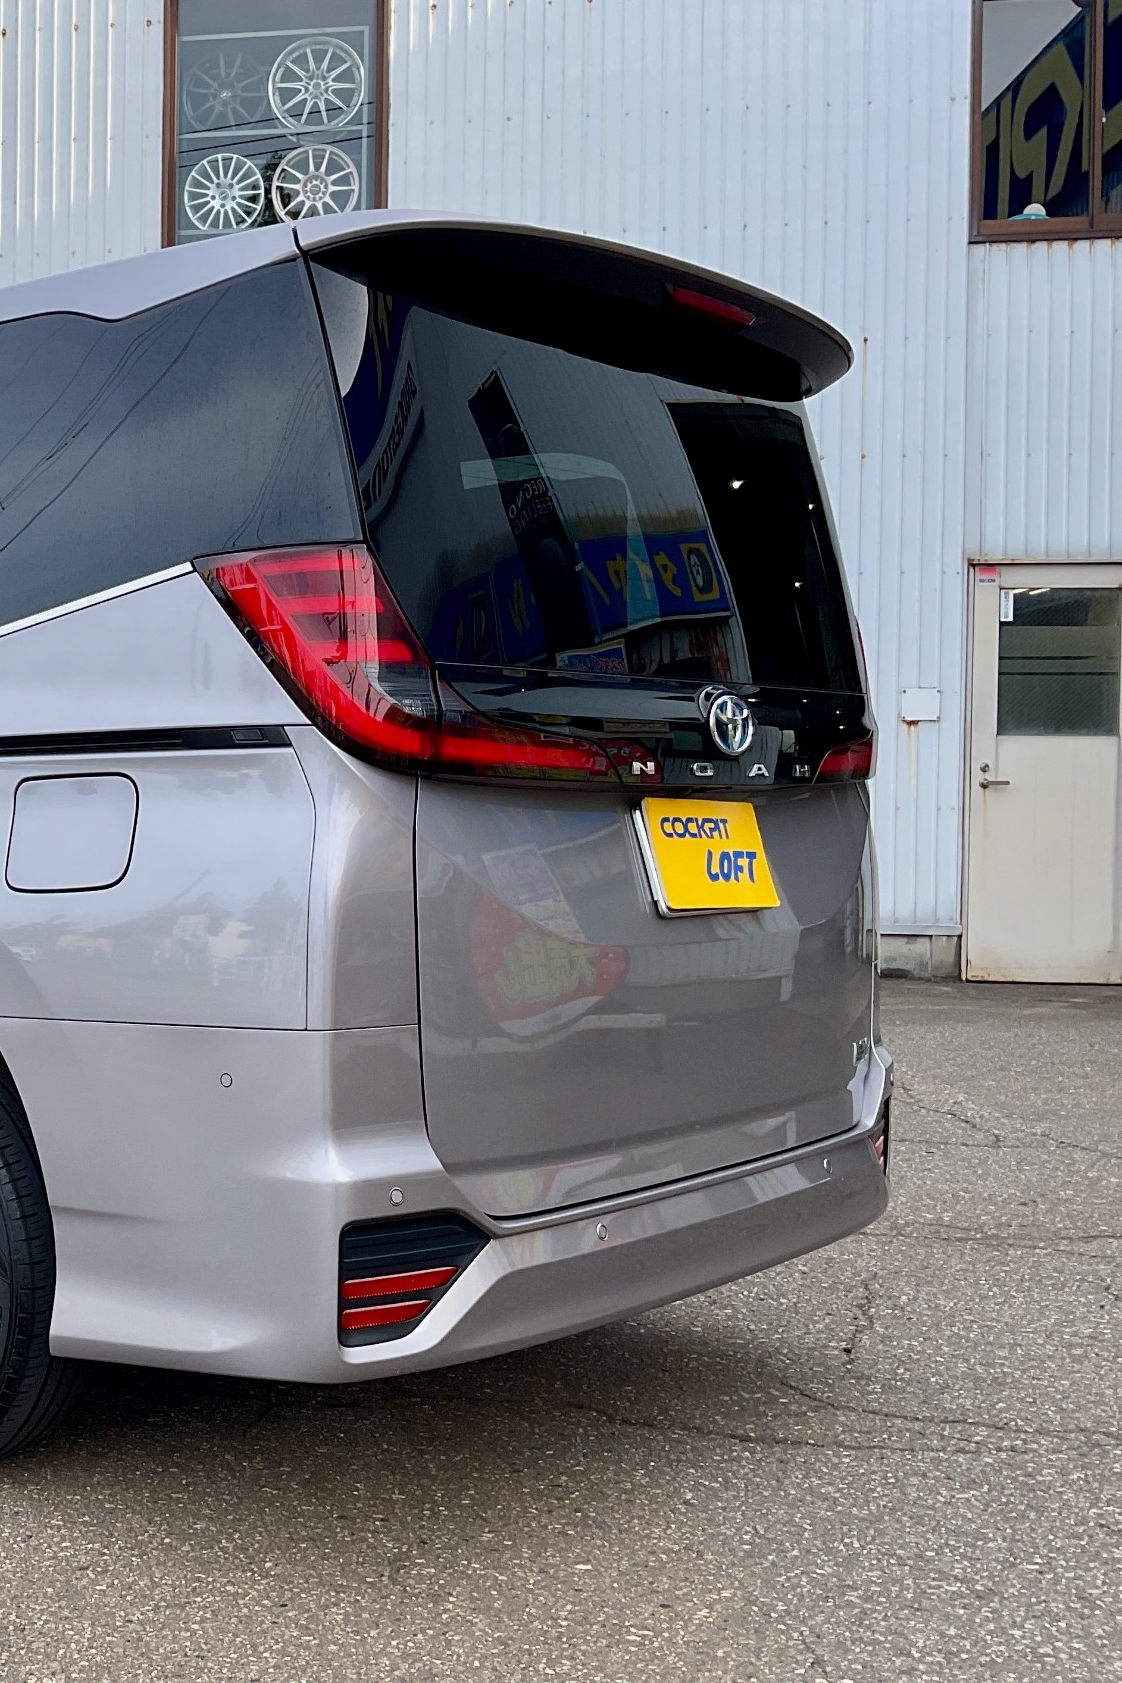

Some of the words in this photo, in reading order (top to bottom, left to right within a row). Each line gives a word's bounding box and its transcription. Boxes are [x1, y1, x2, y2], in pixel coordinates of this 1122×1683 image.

[631, 761, 811, 778] NOAH
[660, 816, 730, 840] COCKPIT
[706, 849, 757, 883] LOFT
